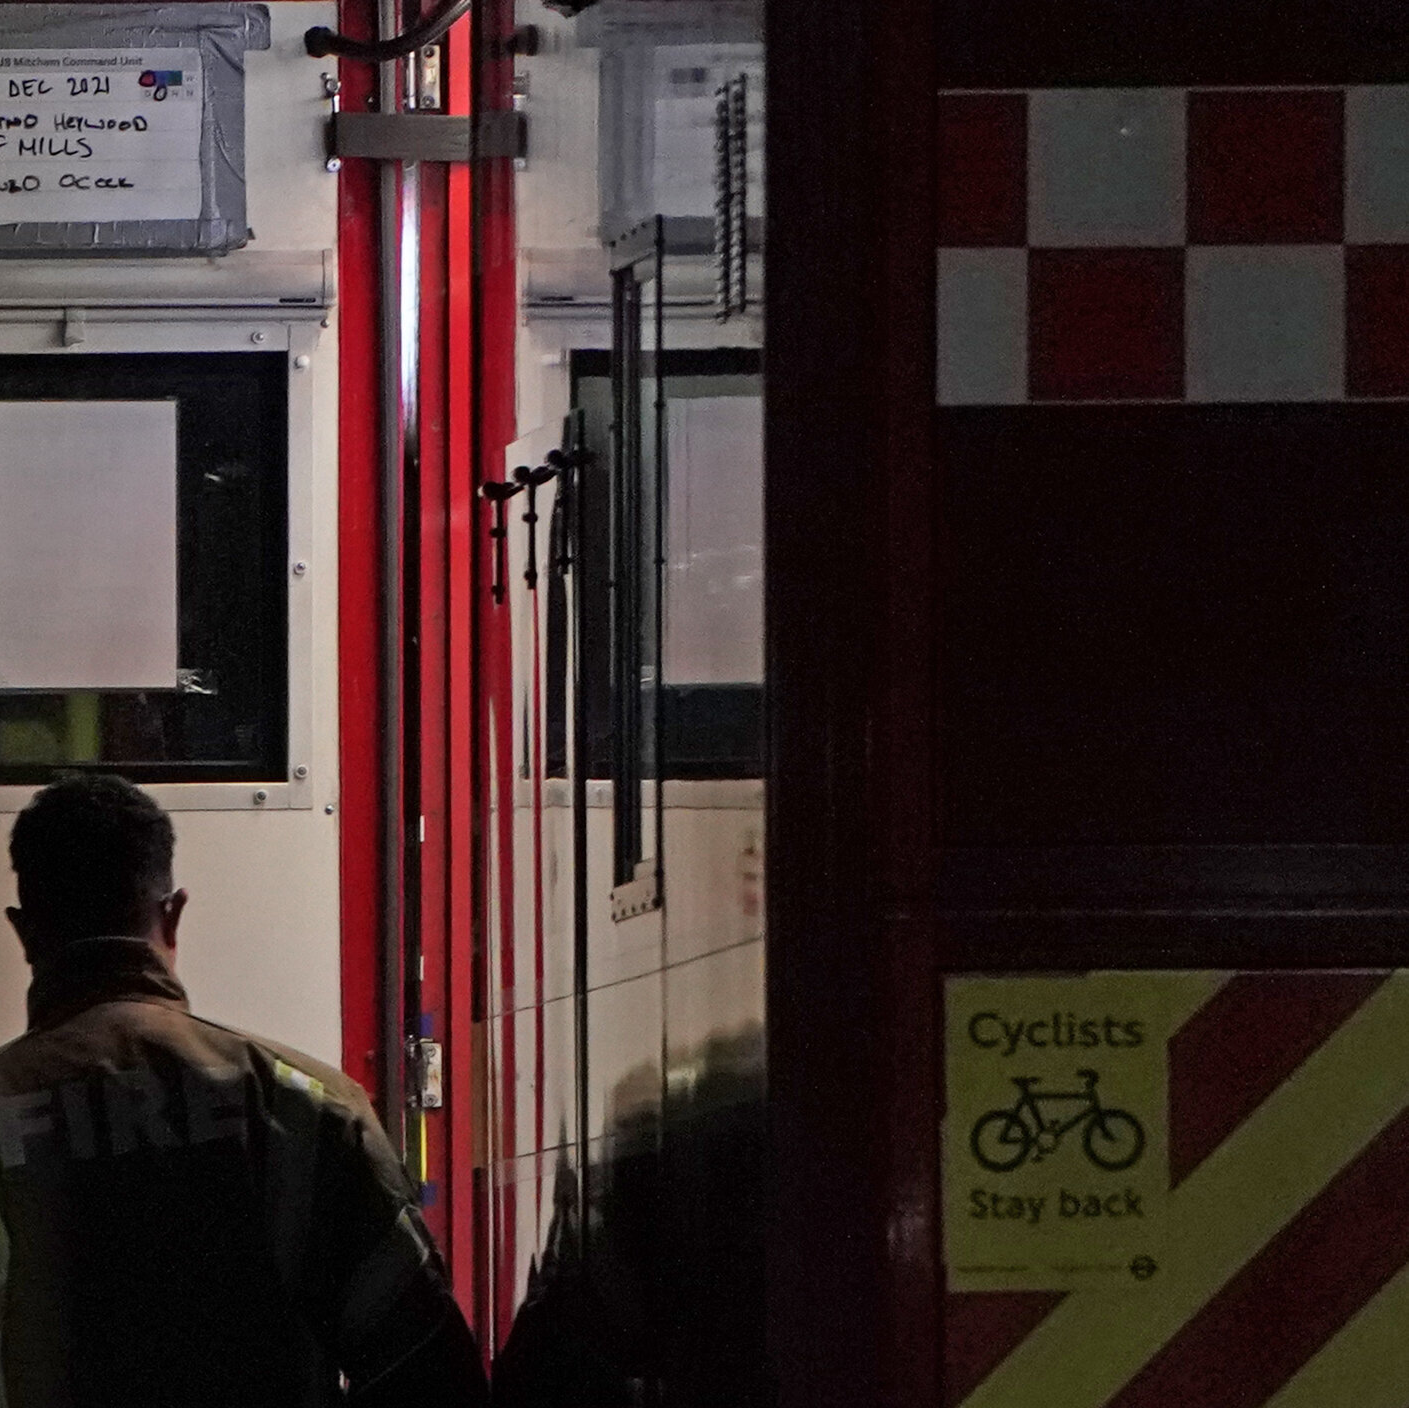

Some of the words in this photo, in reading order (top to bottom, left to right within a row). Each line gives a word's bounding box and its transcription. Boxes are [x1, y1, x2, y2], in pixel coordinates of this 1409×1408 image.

[13, 56, 60, 67] Mitcham
[62, 56, 117, 67] Command
[120, 56, 143, 66] Unit
[9, 77, 53, 98] DEC
[67, 76, 110, 96] 2021
[19, 136, 93, 158] MILLS
[967, 1011, 1144, 1056] Cyclists
[968, 1190, 1046, 1224] Stay
[1058, 1188, 1144, 1218] back
